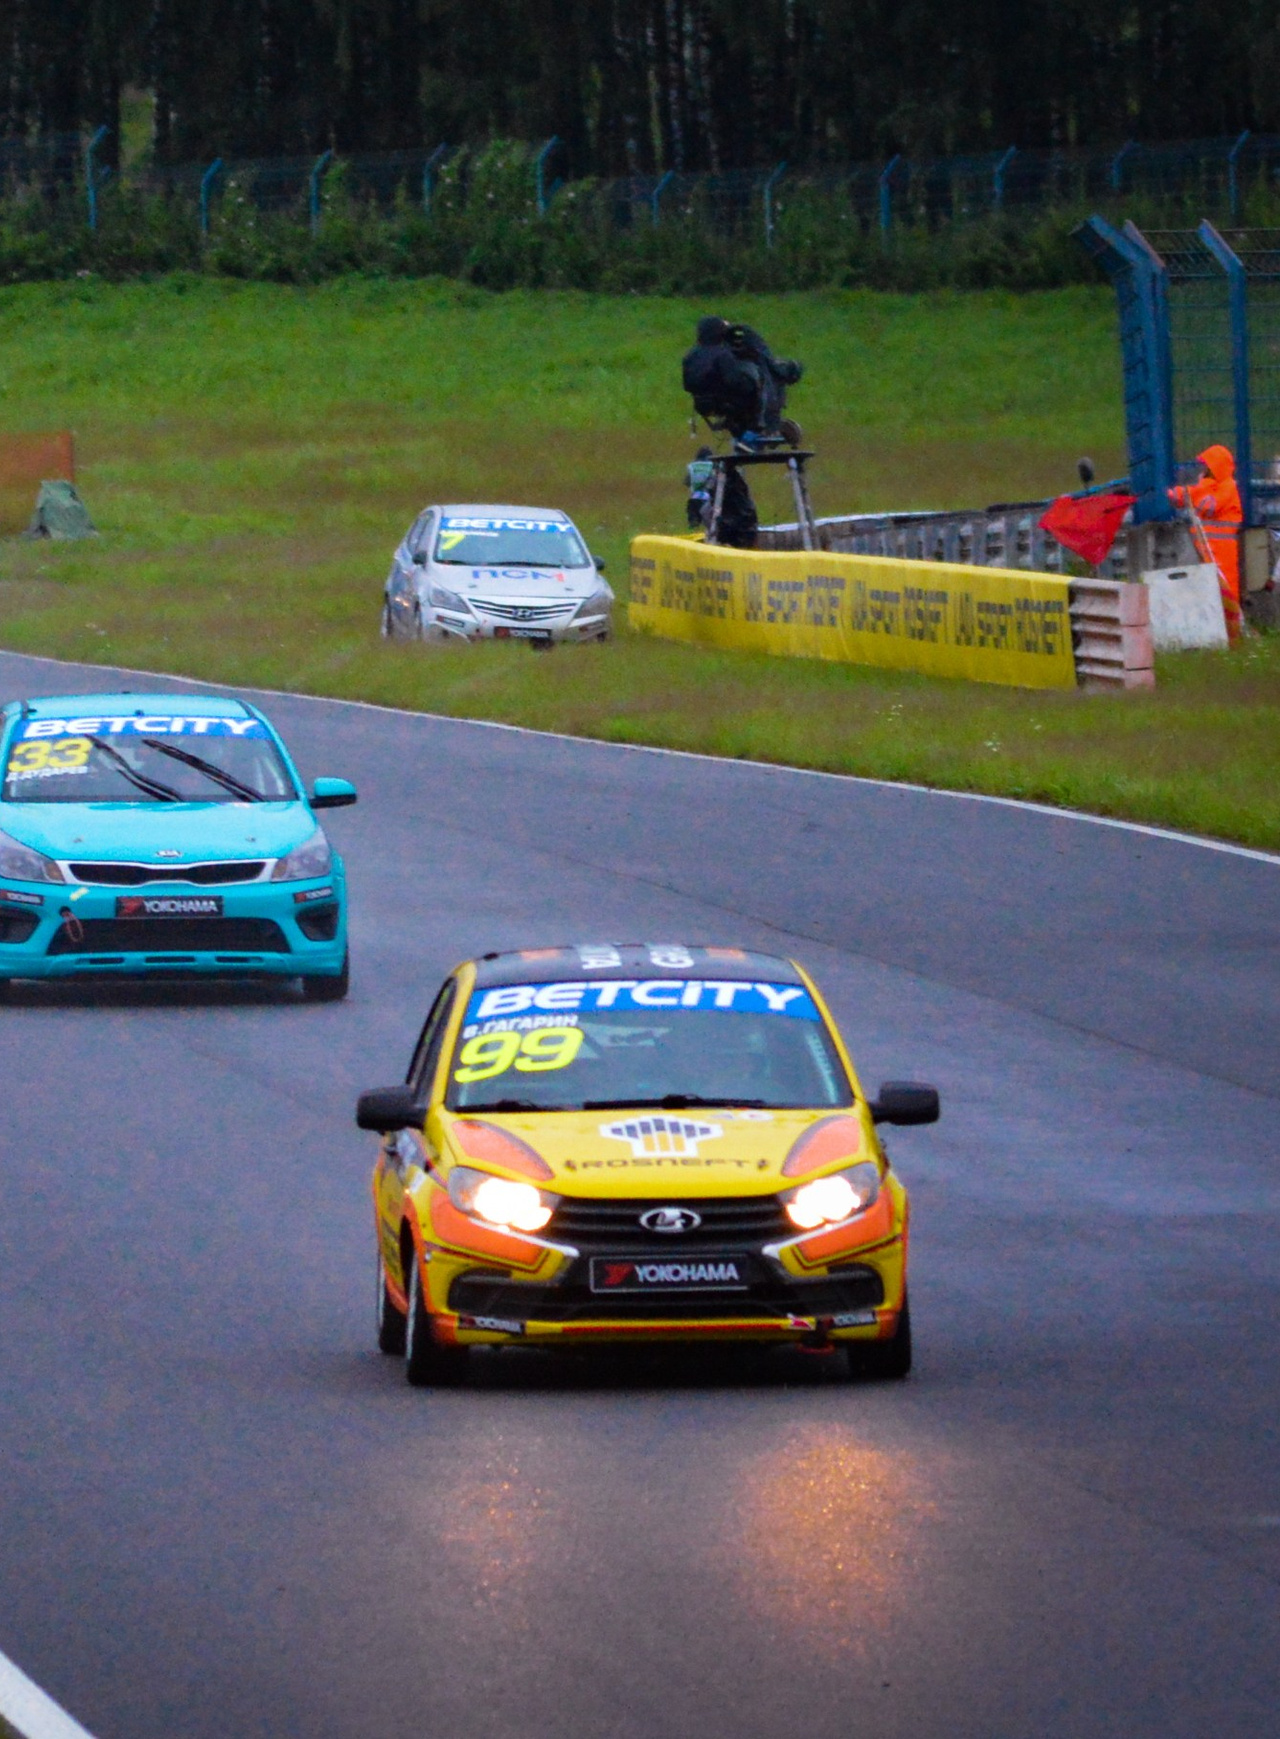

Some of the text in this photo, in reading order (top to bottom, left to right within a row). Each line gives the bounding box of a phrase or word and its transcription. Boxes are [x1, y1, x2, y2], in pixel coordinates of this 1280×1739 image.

[448, 518, 571, 532] BETCITY
[441, 532, 466, 550] 7
[24, 717, 257, 737] BETCITY
[8, 738, 92, 772] 33
[143, 899, 219, 914] YOKOHAMA
[477, 981, 804, 1017] BETCITY
[454, 1026, 585, 1083] 99
[635, 1263, 740, 1283] YOKOHAMA
